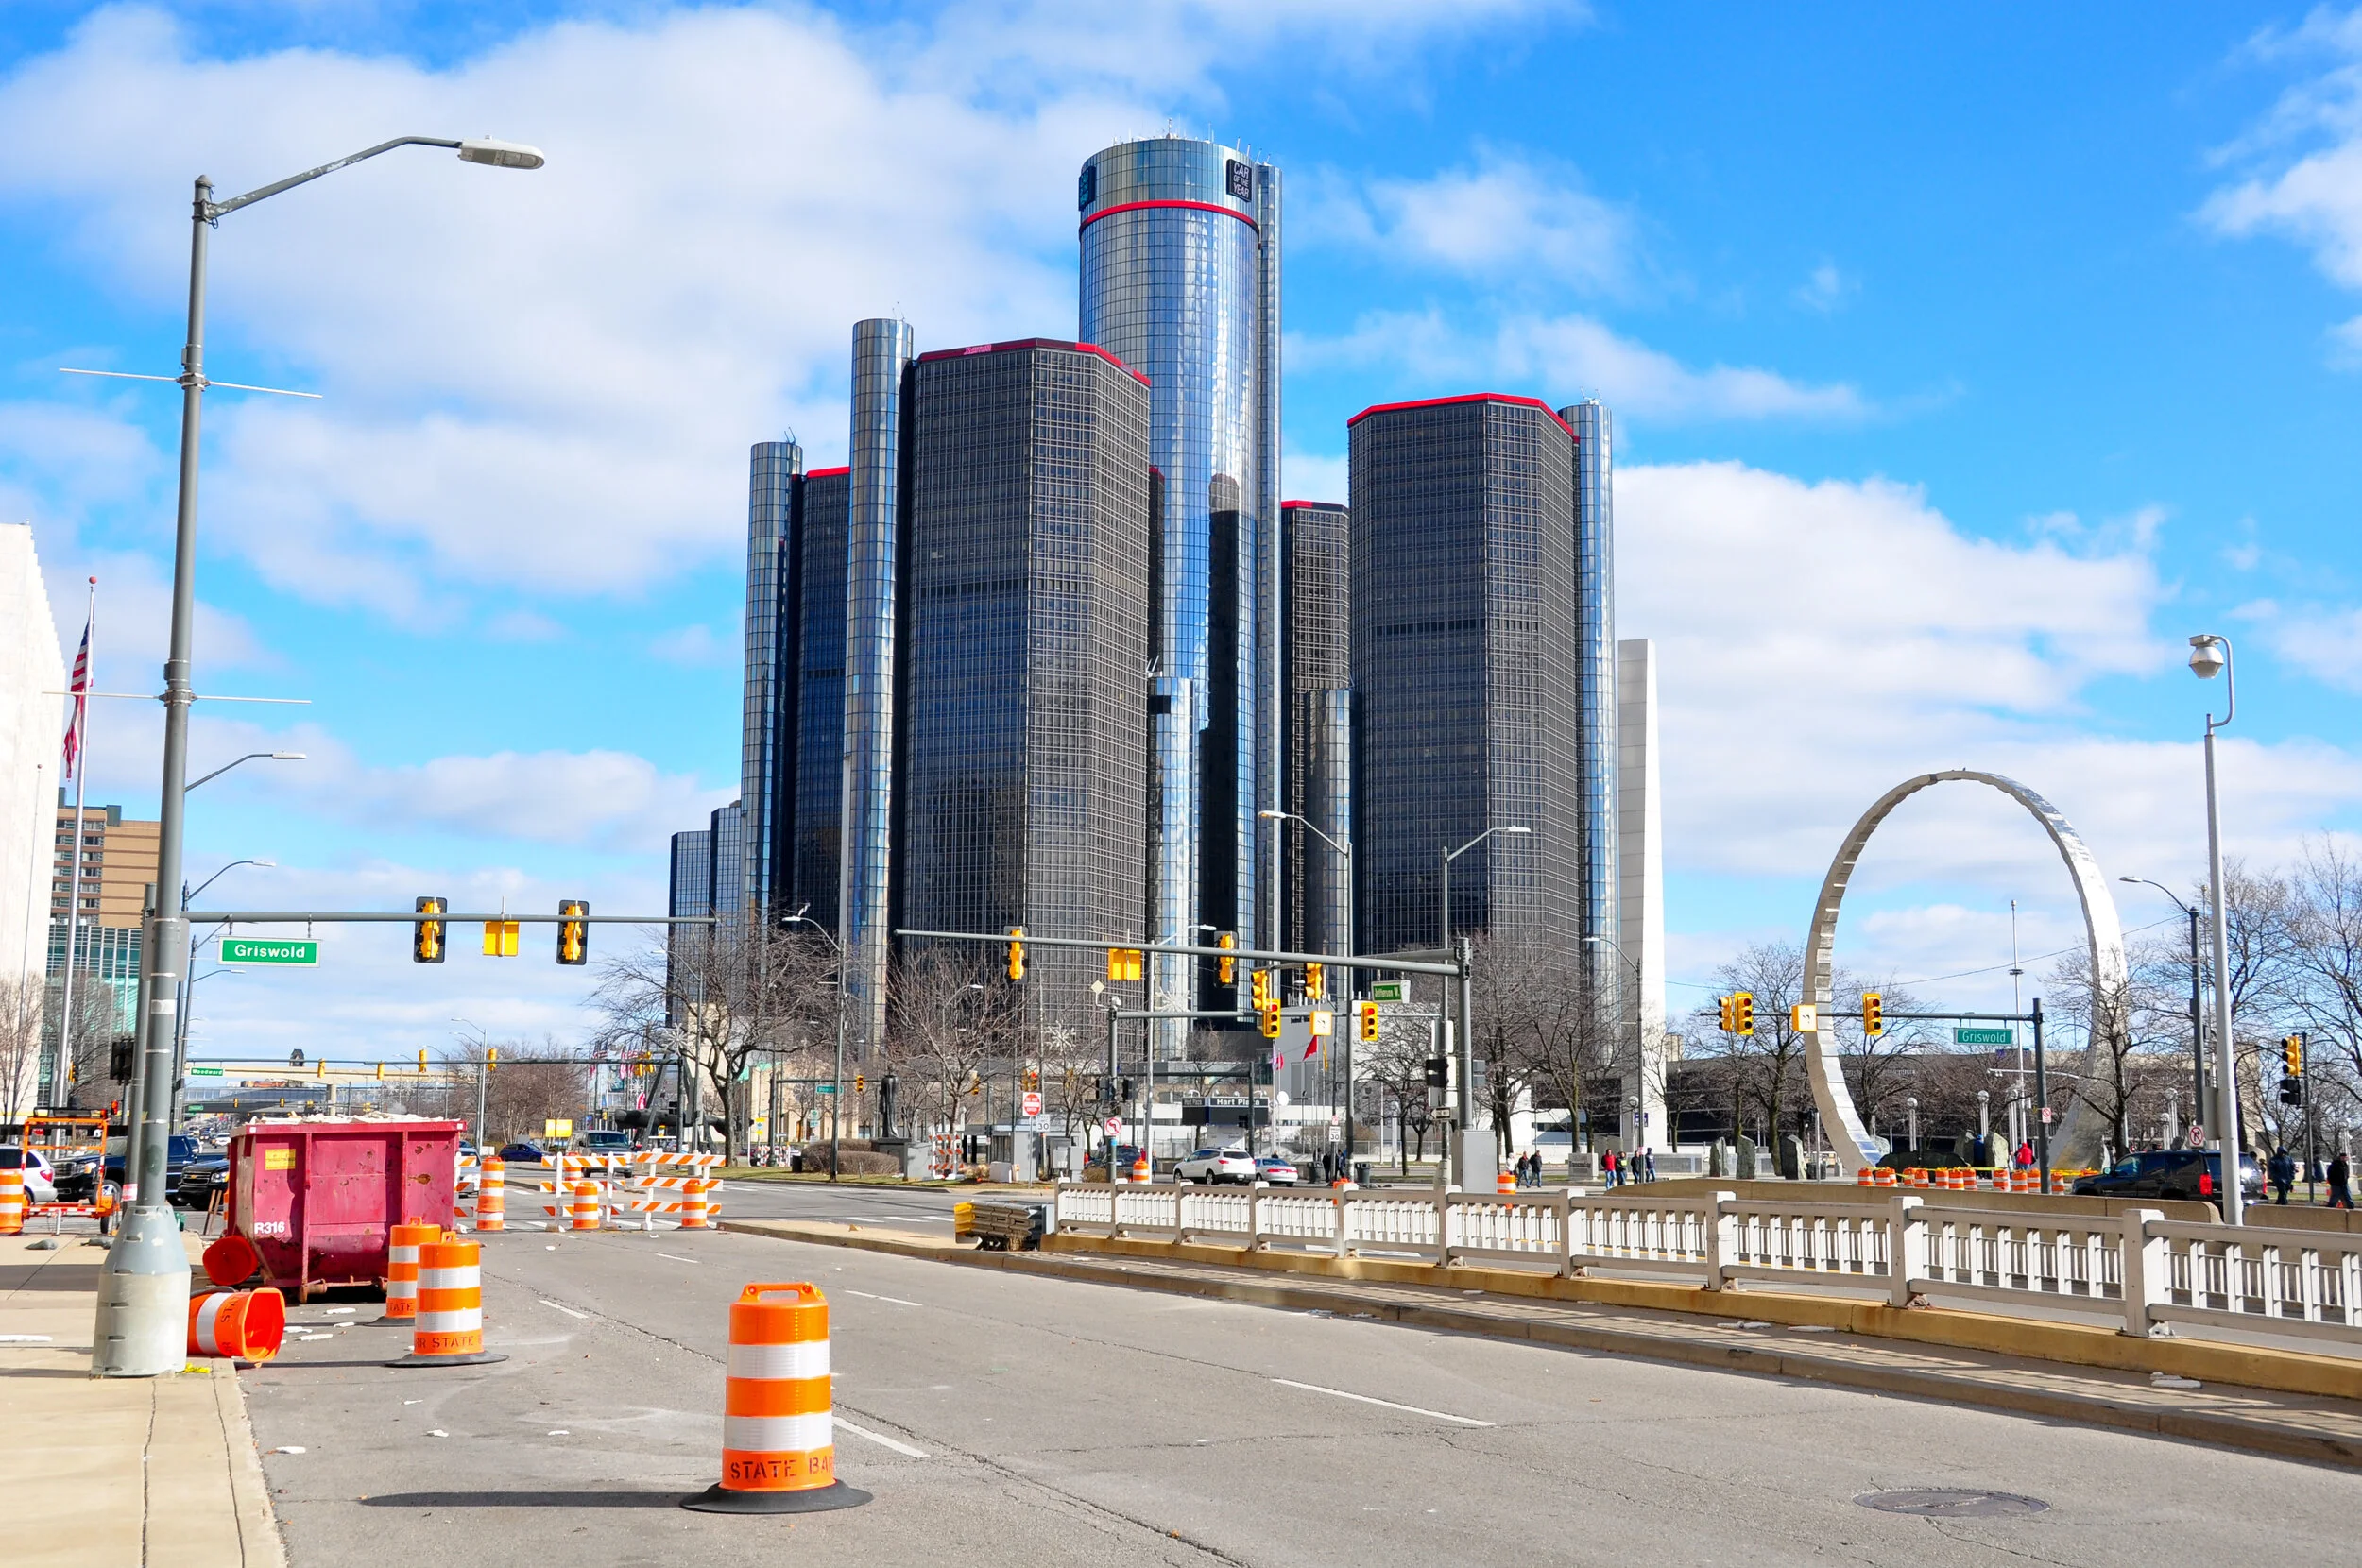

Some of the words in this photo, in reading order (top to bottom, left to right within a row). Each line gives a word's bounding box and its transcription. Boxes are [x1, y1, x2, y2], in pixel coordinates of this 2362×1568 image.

[1233, 162, 1249, 179] CAR
[1233, 174, 1241, 182] OF
[1240, 177, 1249, 187] THE
[1233, 182, 1249, 198] YEAR
[234, 944, 306, 959] Griswold
[1962, 1031, 2007, 1043] Griswold
[1038, 1122, 1049, 1131] 30
[254, 1221, 285, 1234] R316
[432, 1335, 474, 1349] STATE
[730, 1459, 797, 1480] STATE
